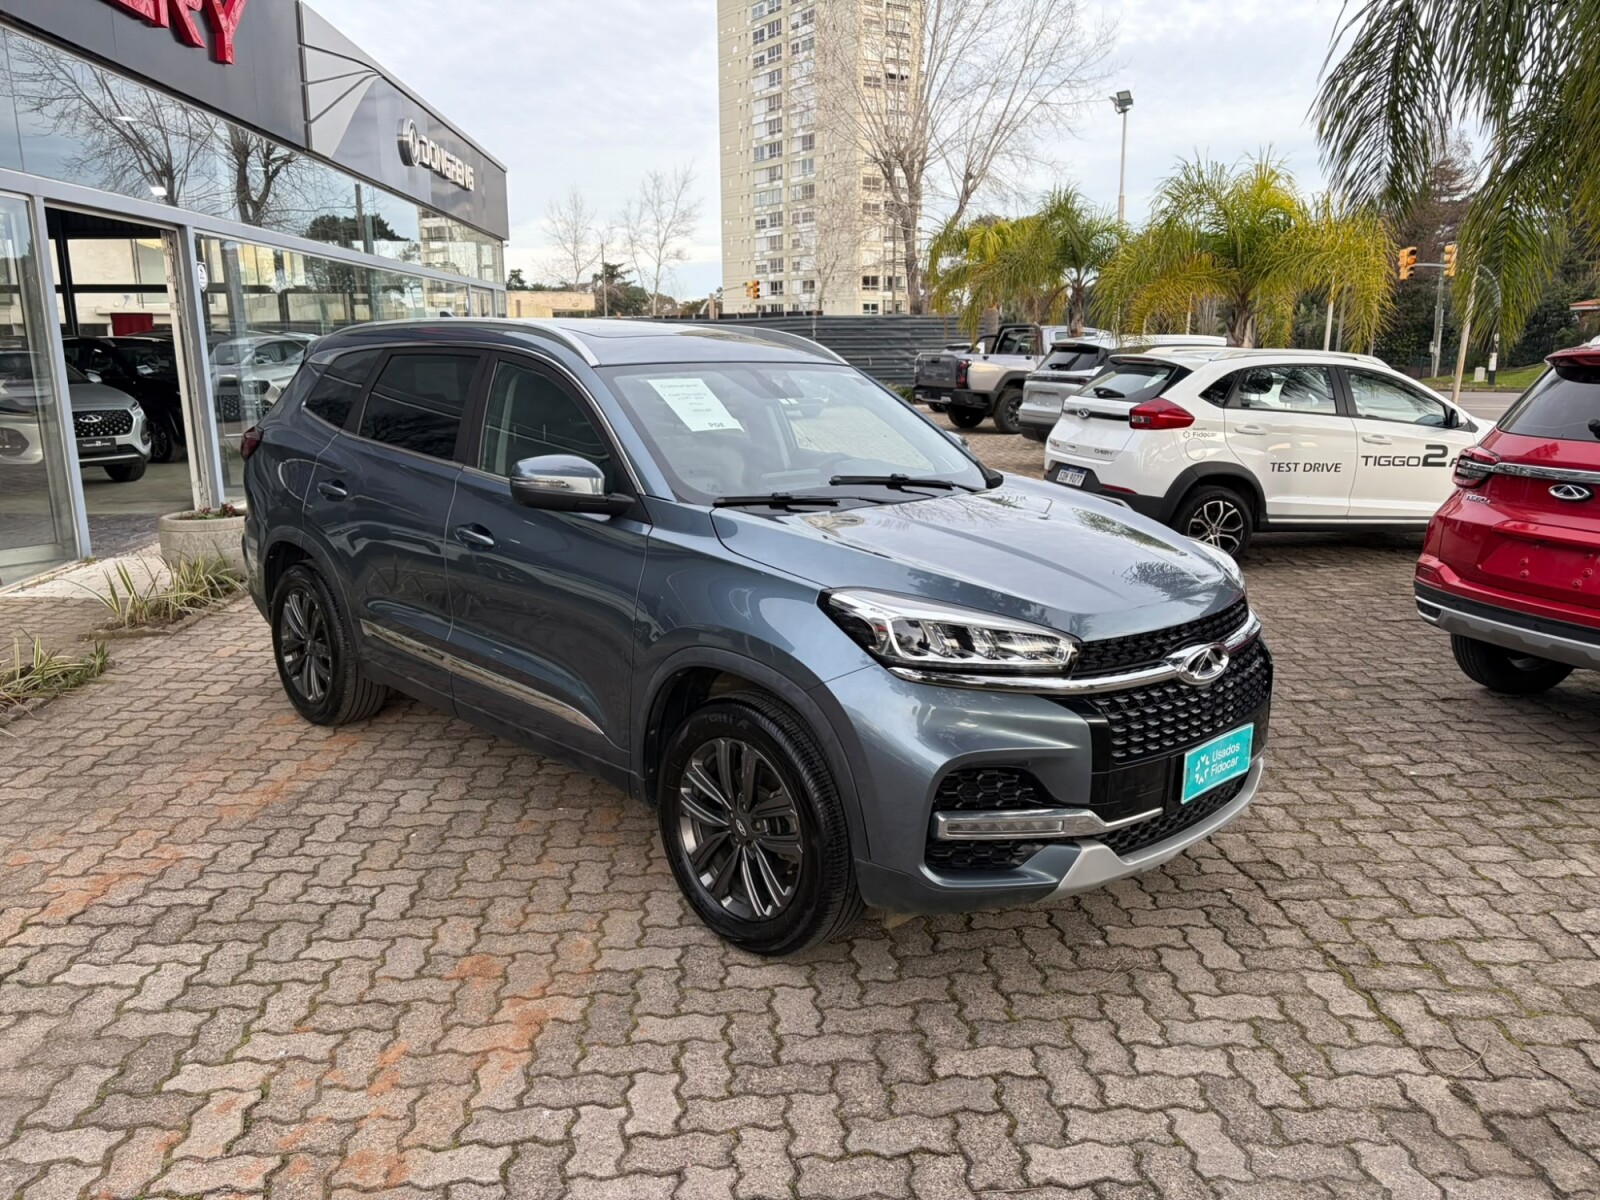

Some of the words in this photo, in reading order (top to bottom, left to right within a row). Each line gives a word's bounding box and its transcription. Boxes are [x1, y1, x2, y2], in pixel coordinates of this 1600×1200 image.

[419, 134, 475, 192] DONGFENG
[1094, 448, 1114, 456] CHERY
[1270, 462, 1300, 473] TEST
[1302, 462, 1342, 473] DRIVE
[1212, 742, 1240, 762] Usados
[1210, 756, 1239, 776] Fidocar
